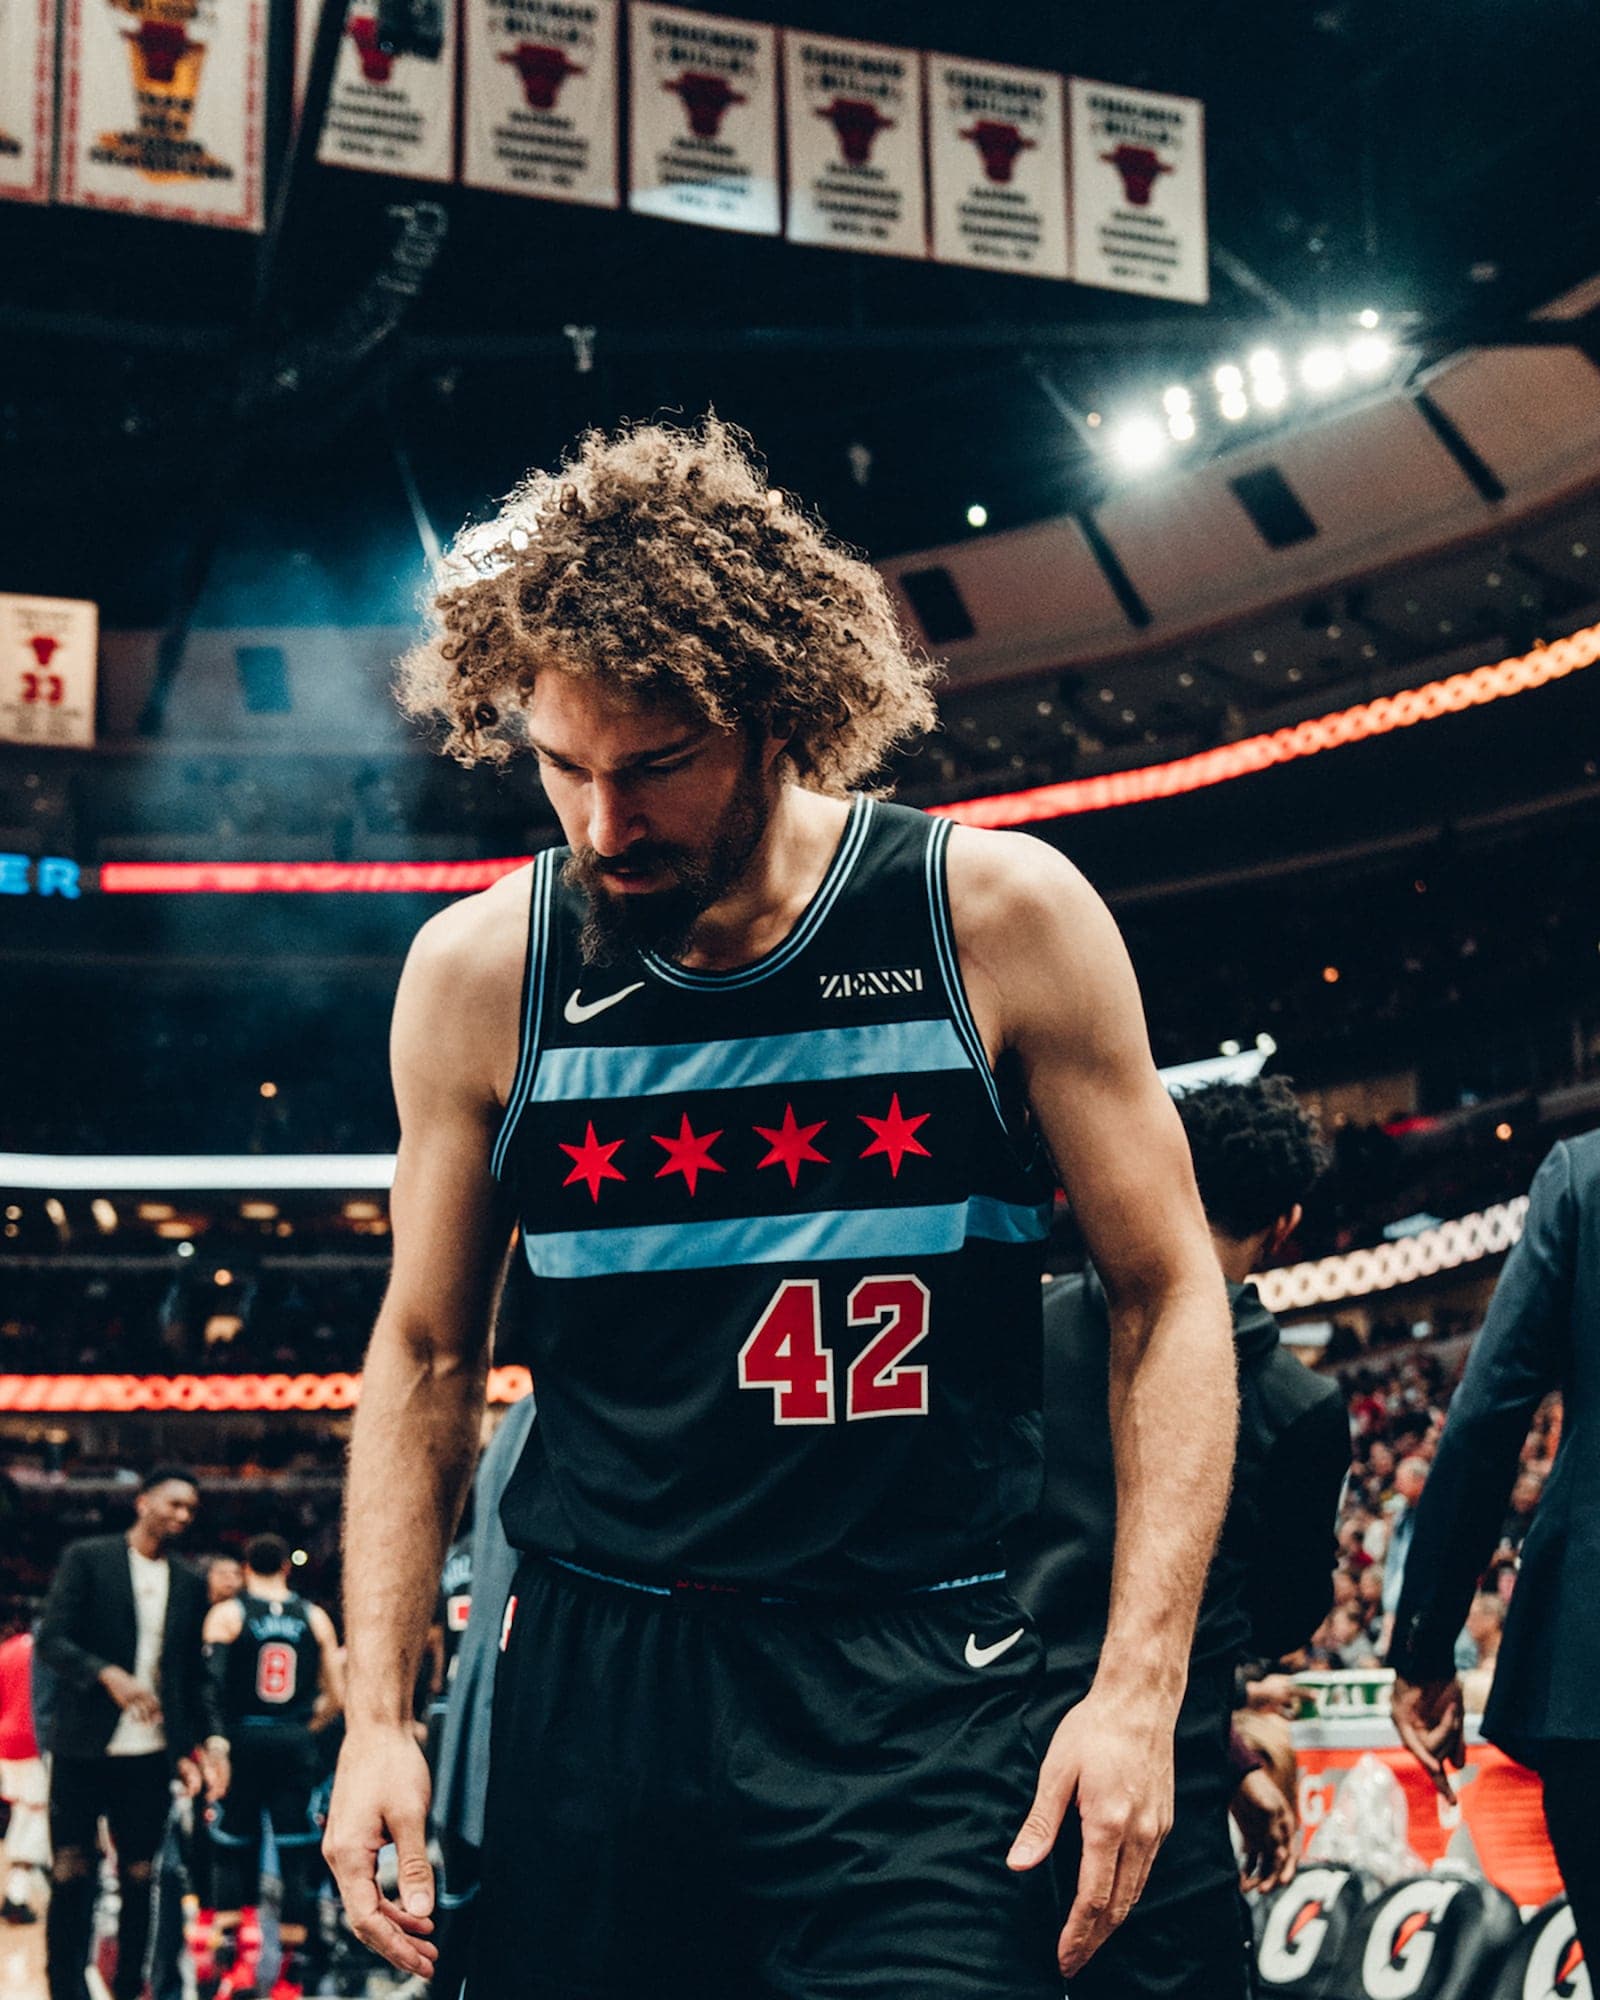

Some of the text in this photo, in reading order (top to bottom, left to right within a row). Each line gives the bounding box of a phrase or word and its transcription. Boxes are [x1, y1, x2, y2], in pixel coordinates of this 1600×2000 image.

[819, 968, 923, 999] ZENNI
[738, 1273, 931, 1425] 42
[256, 1642, 297, 1704] 8
[1258, 1868, 1350, 1984] G
[1362, 1879, 1463, 2000] G
